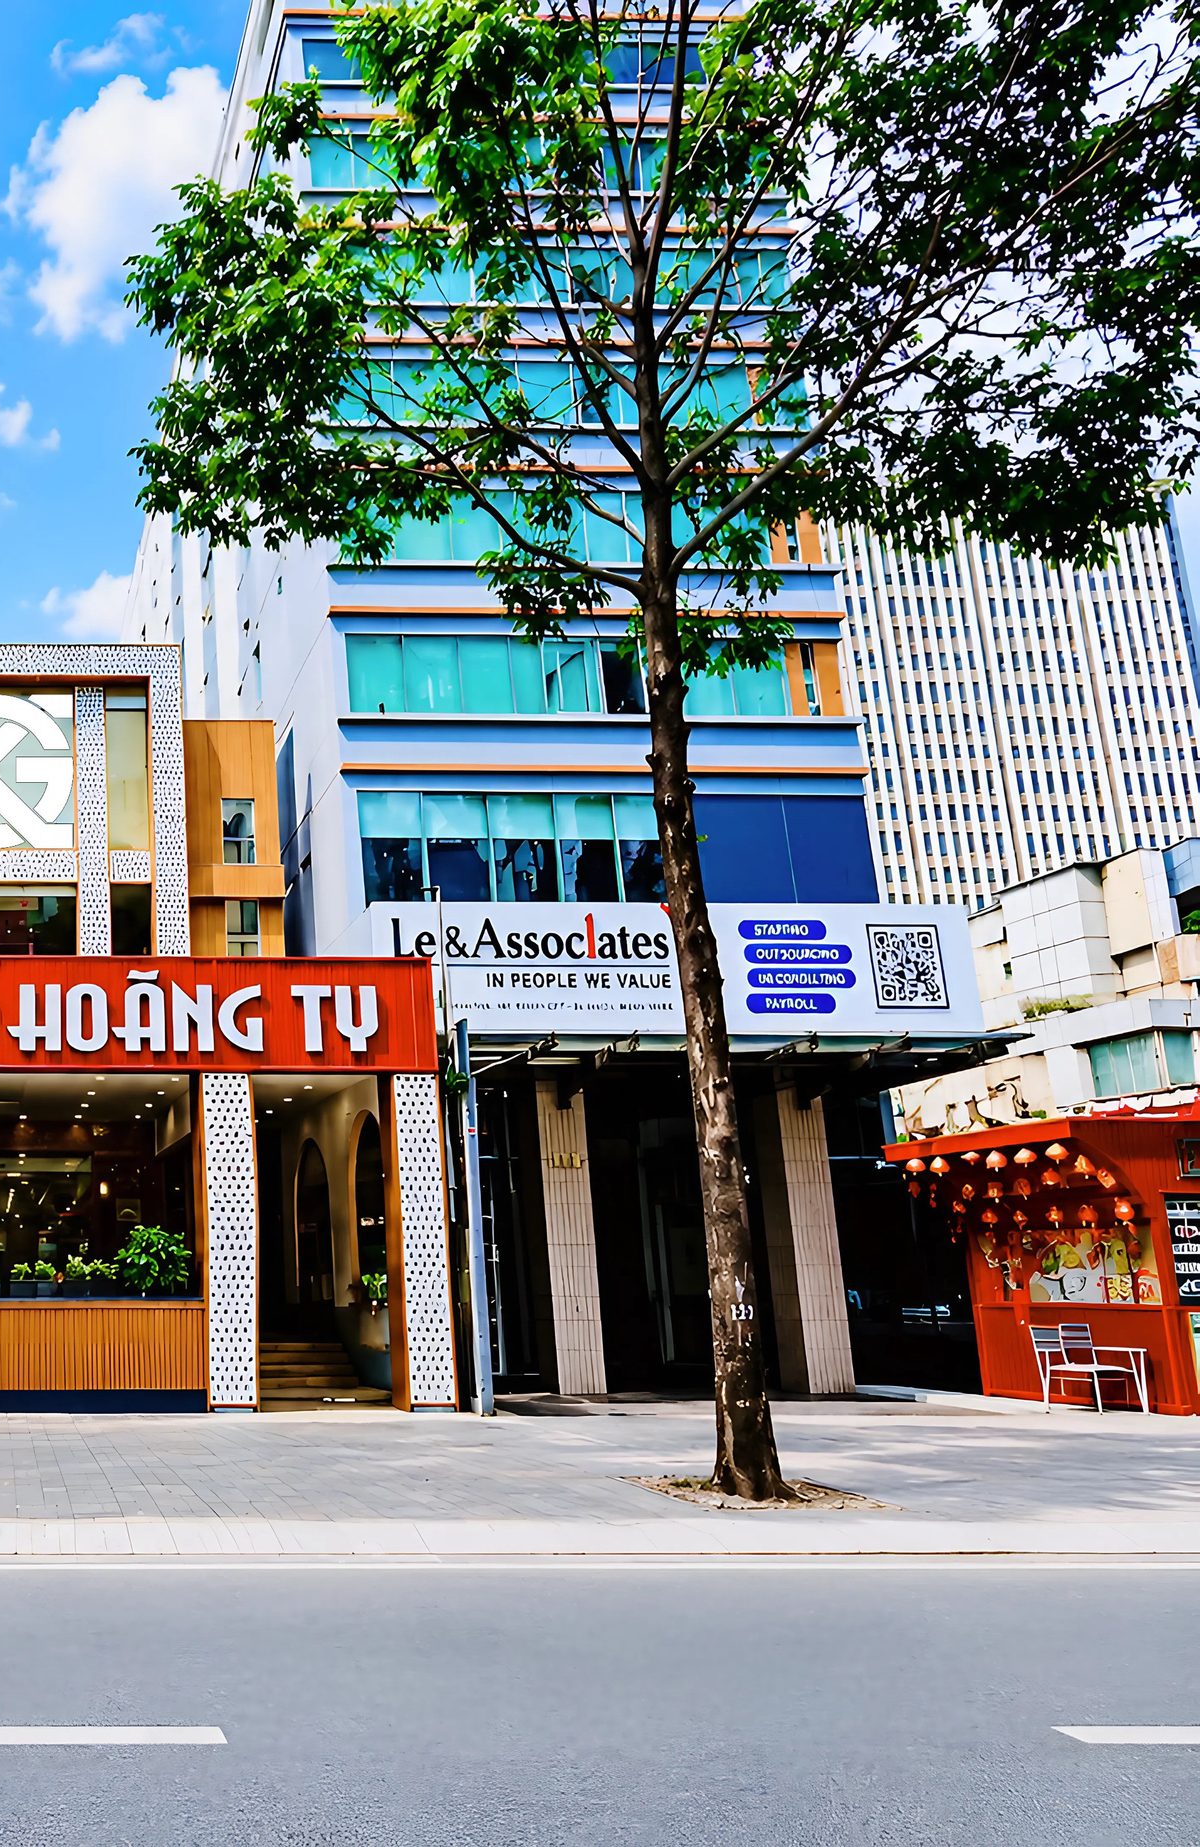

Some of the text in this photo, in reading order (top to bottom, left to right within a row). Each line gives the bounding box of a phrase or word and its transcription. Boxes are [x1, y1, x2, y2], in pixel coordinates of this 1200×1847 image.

[486, 972, 672, 989] IN PEOPLE WE VALUE
[291, 984, 380, 1053] TY
